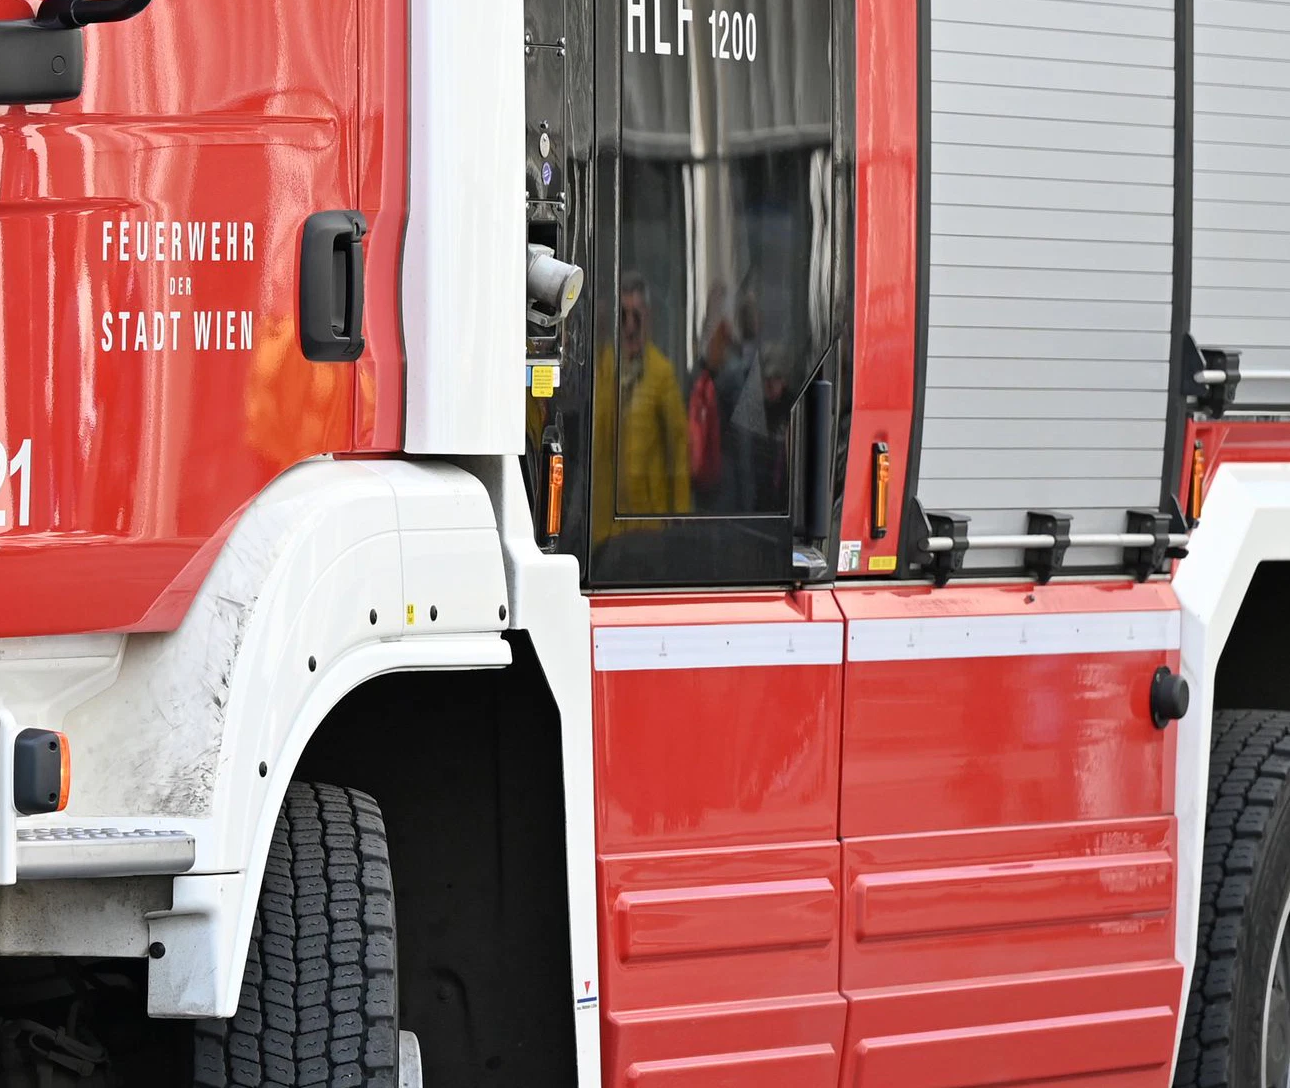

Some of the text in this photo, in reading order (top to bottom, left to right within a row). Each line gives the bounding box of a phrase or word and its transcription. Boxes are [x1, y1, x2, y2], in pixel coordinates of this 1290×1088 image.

[708, 9, 757, 62] 1200
[102, 221, 255, 262] FEUERWEHR
[169, 277, 192, 295] DER
[101, 310, 253, 352] STADT WIEN
